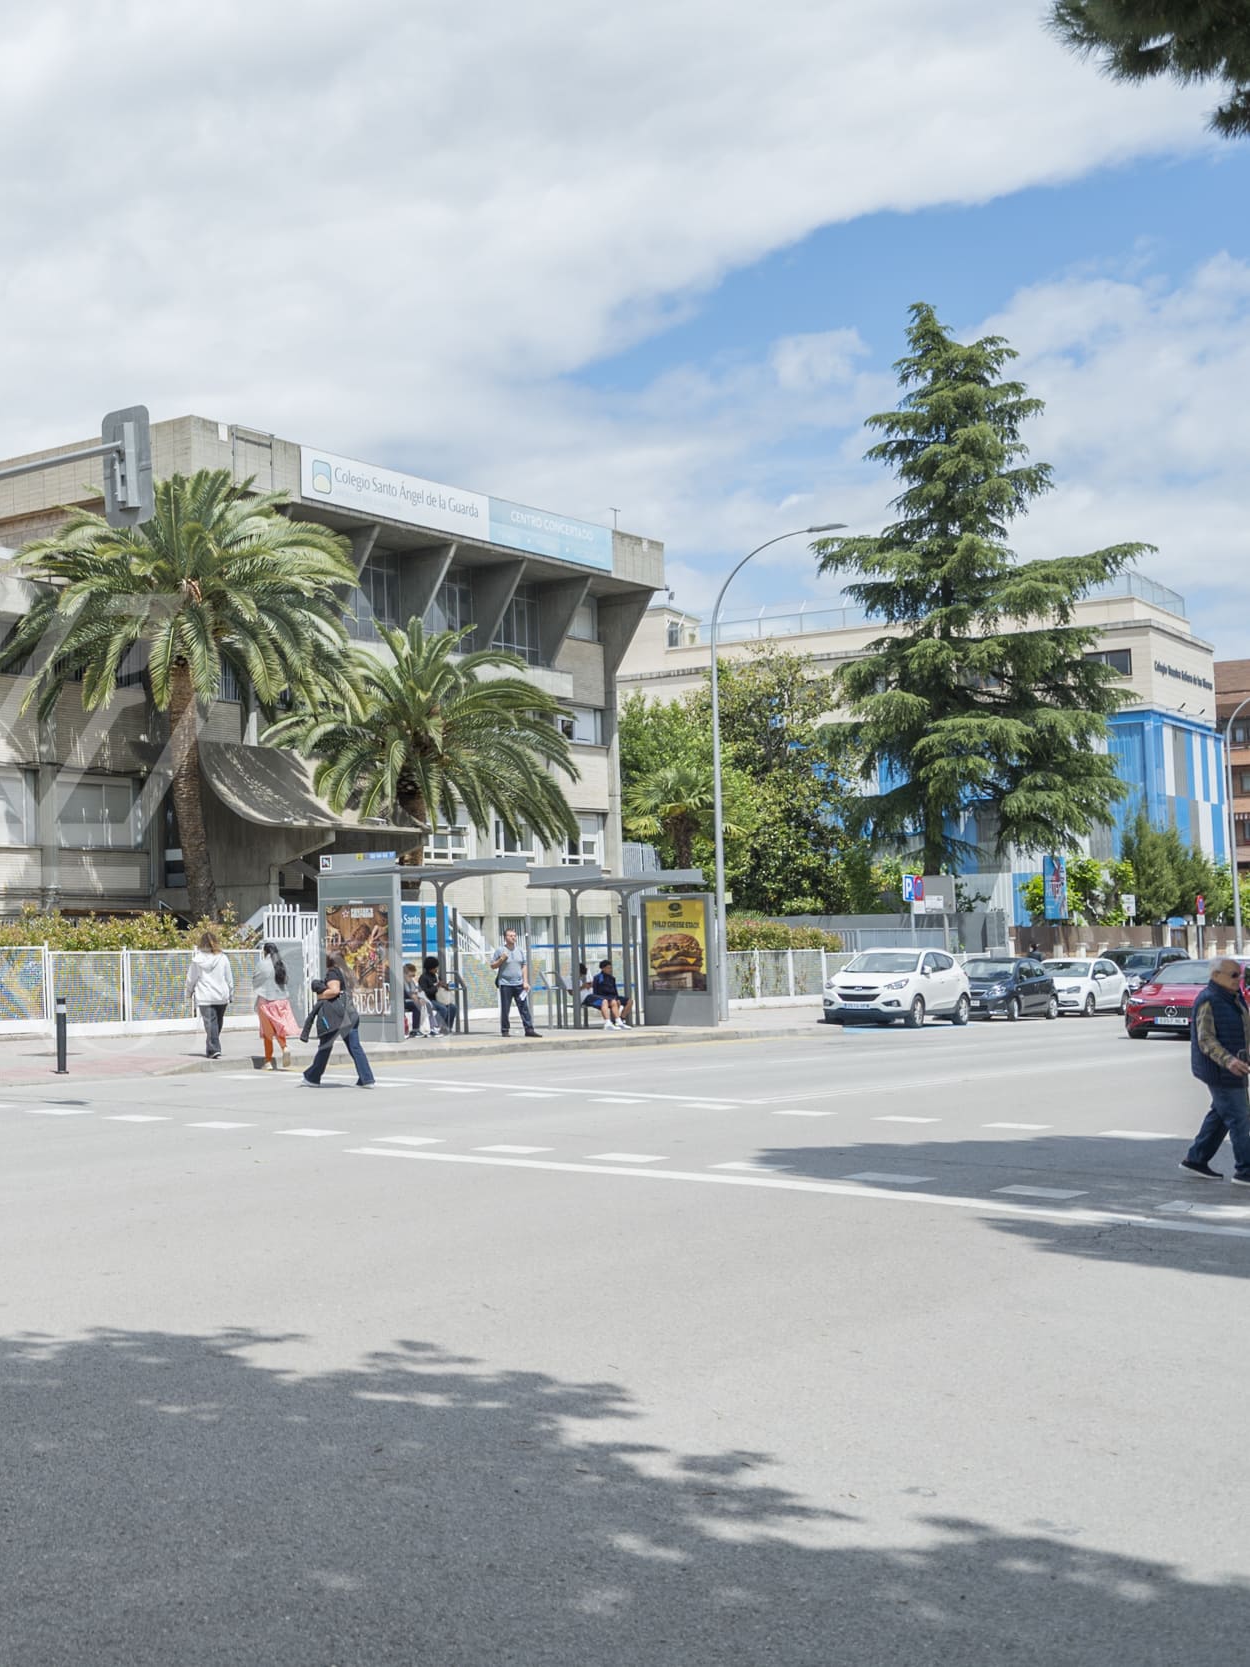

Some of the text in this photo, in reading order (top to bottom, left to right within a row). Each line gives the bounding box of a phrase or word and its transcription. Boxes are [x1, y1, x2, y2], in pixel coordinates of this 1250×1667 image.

[334, 466, 370, 492] Colegio
[372, 477, 398, 497] Santo
[399, 480, 425, 507] Ángel
[426, 495, 437, 508] de
[438, 497, 446, 510] la
[447, 498, 479, 518] Guarda
[510, 511, 542, 529] CENTRO
[403, 914, 421, 925] Santo
